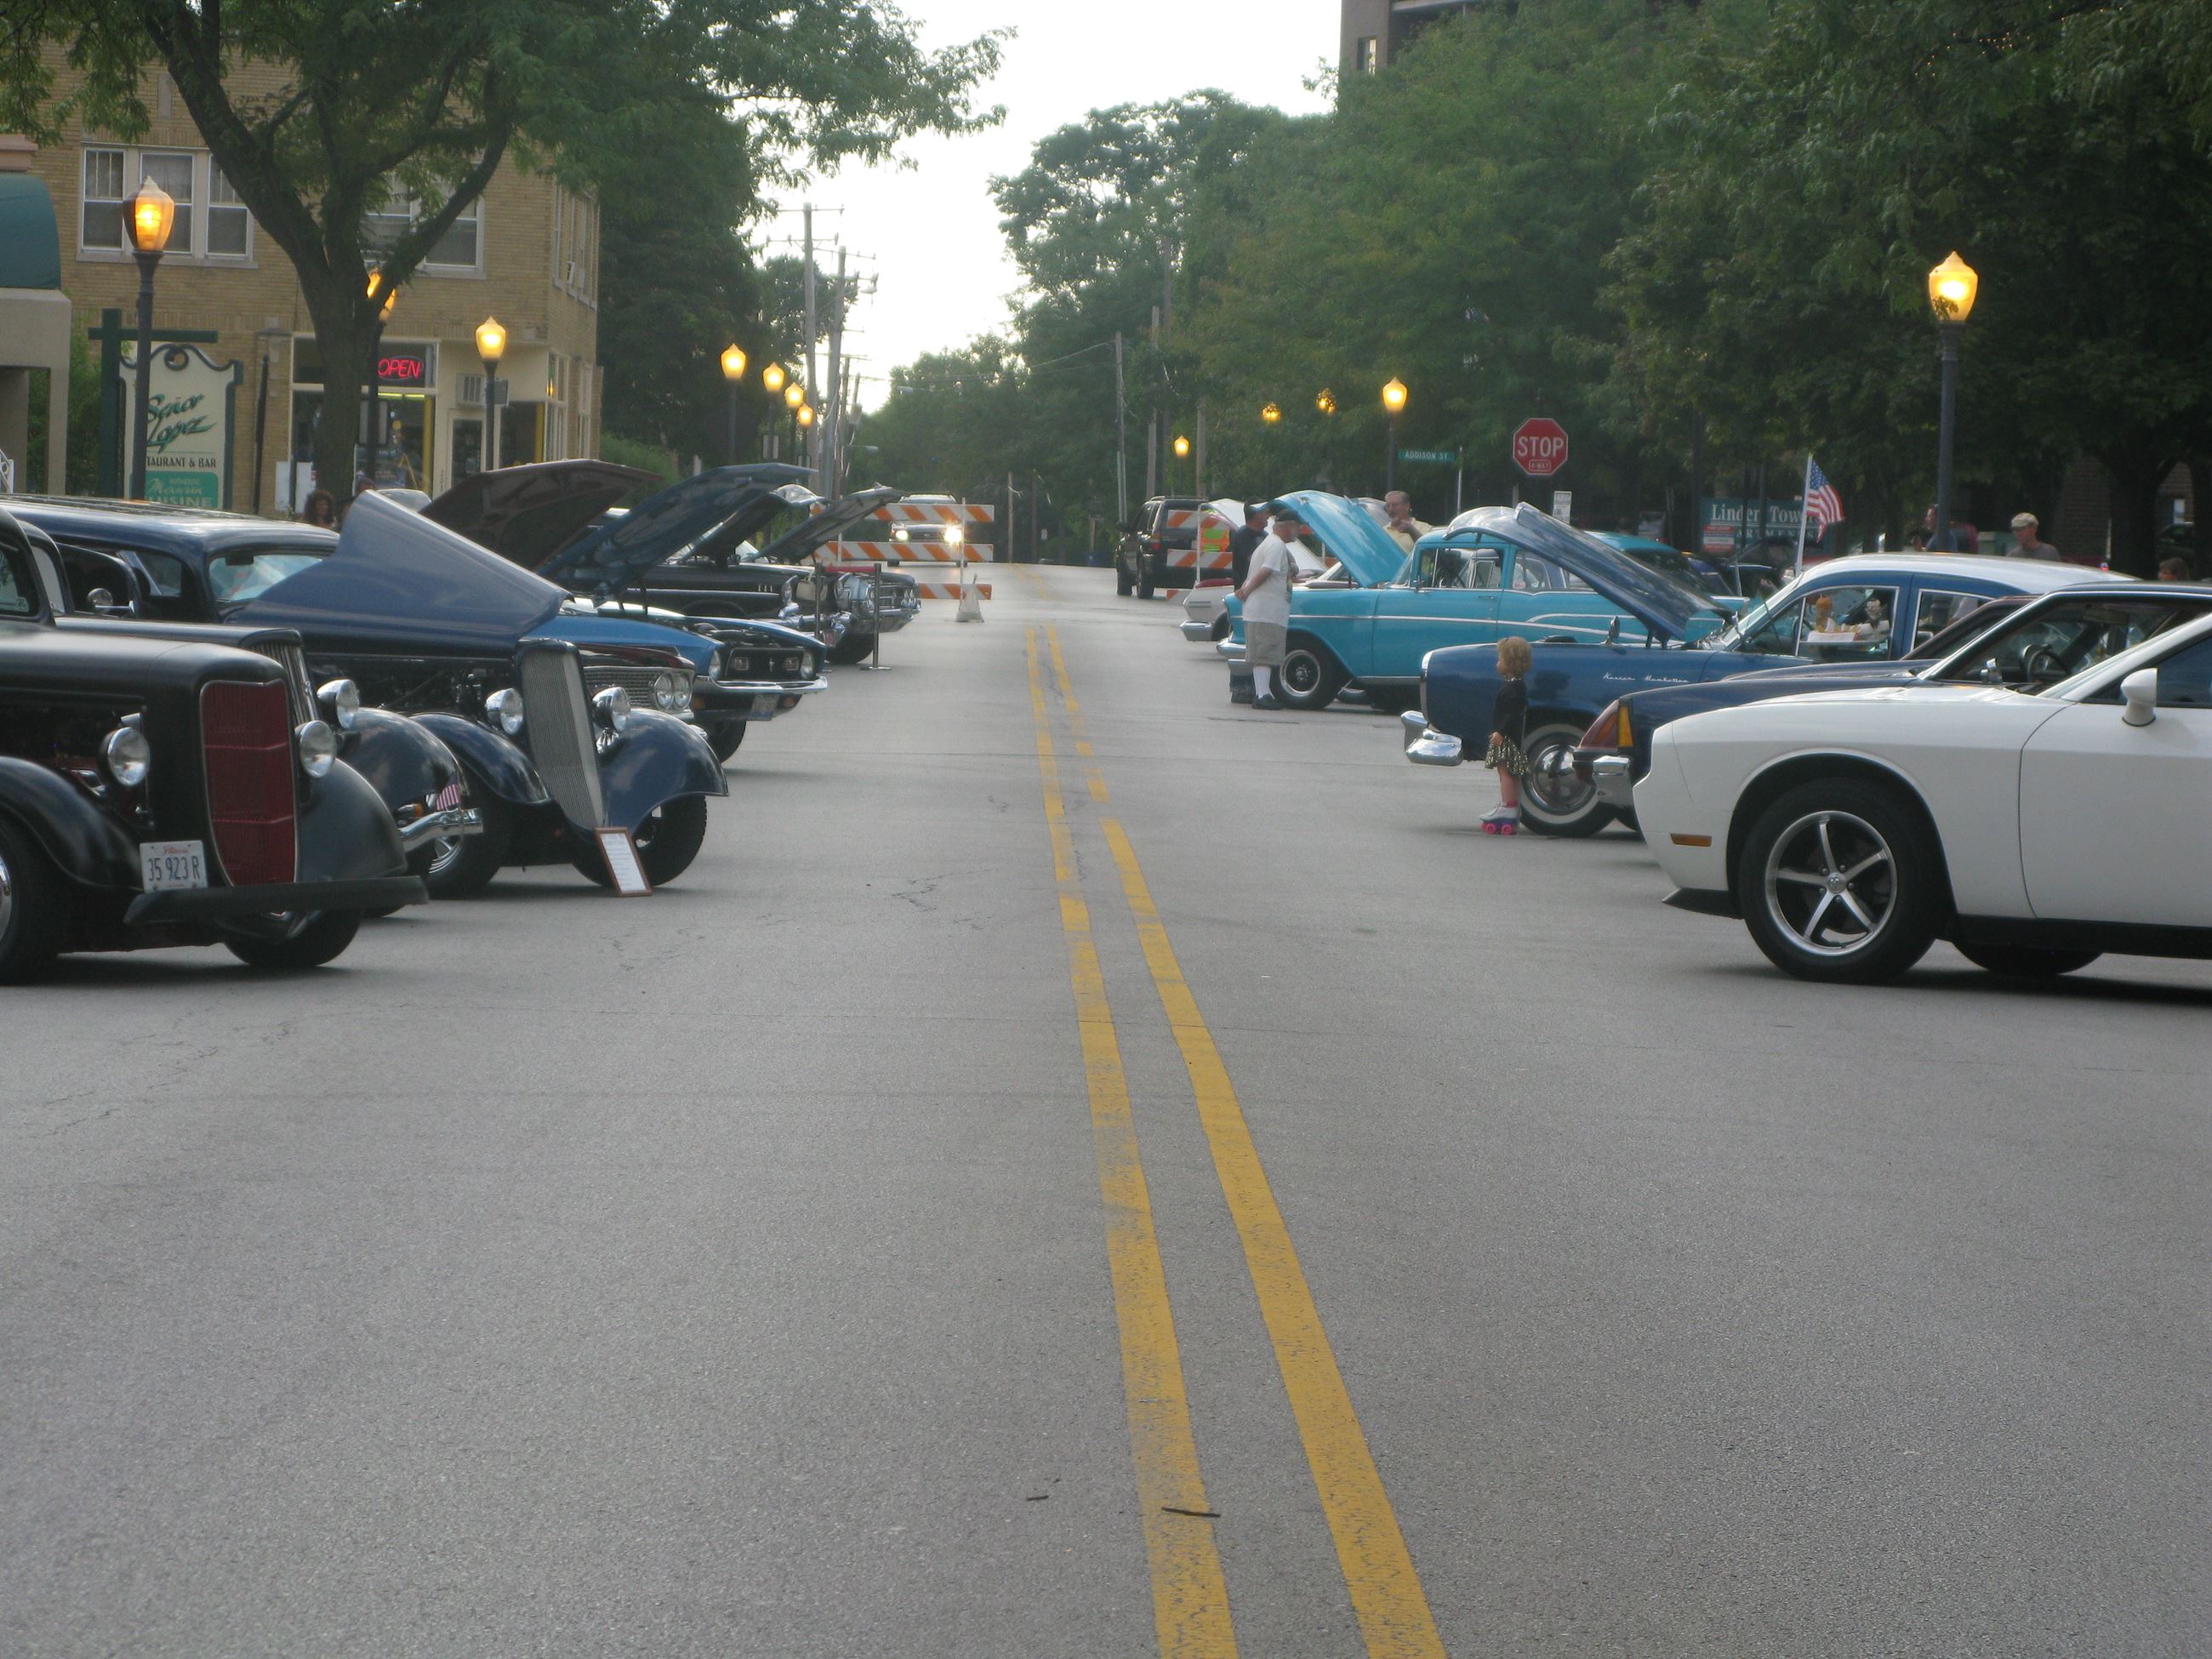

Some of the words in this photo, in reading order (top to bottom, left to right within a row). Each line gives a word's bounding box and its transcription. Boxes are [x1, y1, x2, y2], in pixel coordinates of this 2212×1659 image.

[377, 358, 421, 379] OPEN
[1405, 450, 1436, 460] ADDISON
[1517, 436, 1565, 458] STOP
[146, 456, 185, 468] TAURANT
[188, 457, 195, 468] &
[197, 458, 217, 468] BAR
[145, 496, 211, 507] UISINE
[1712, 504, 1760, 522] Linder
[191, 855, 201, 879] R
